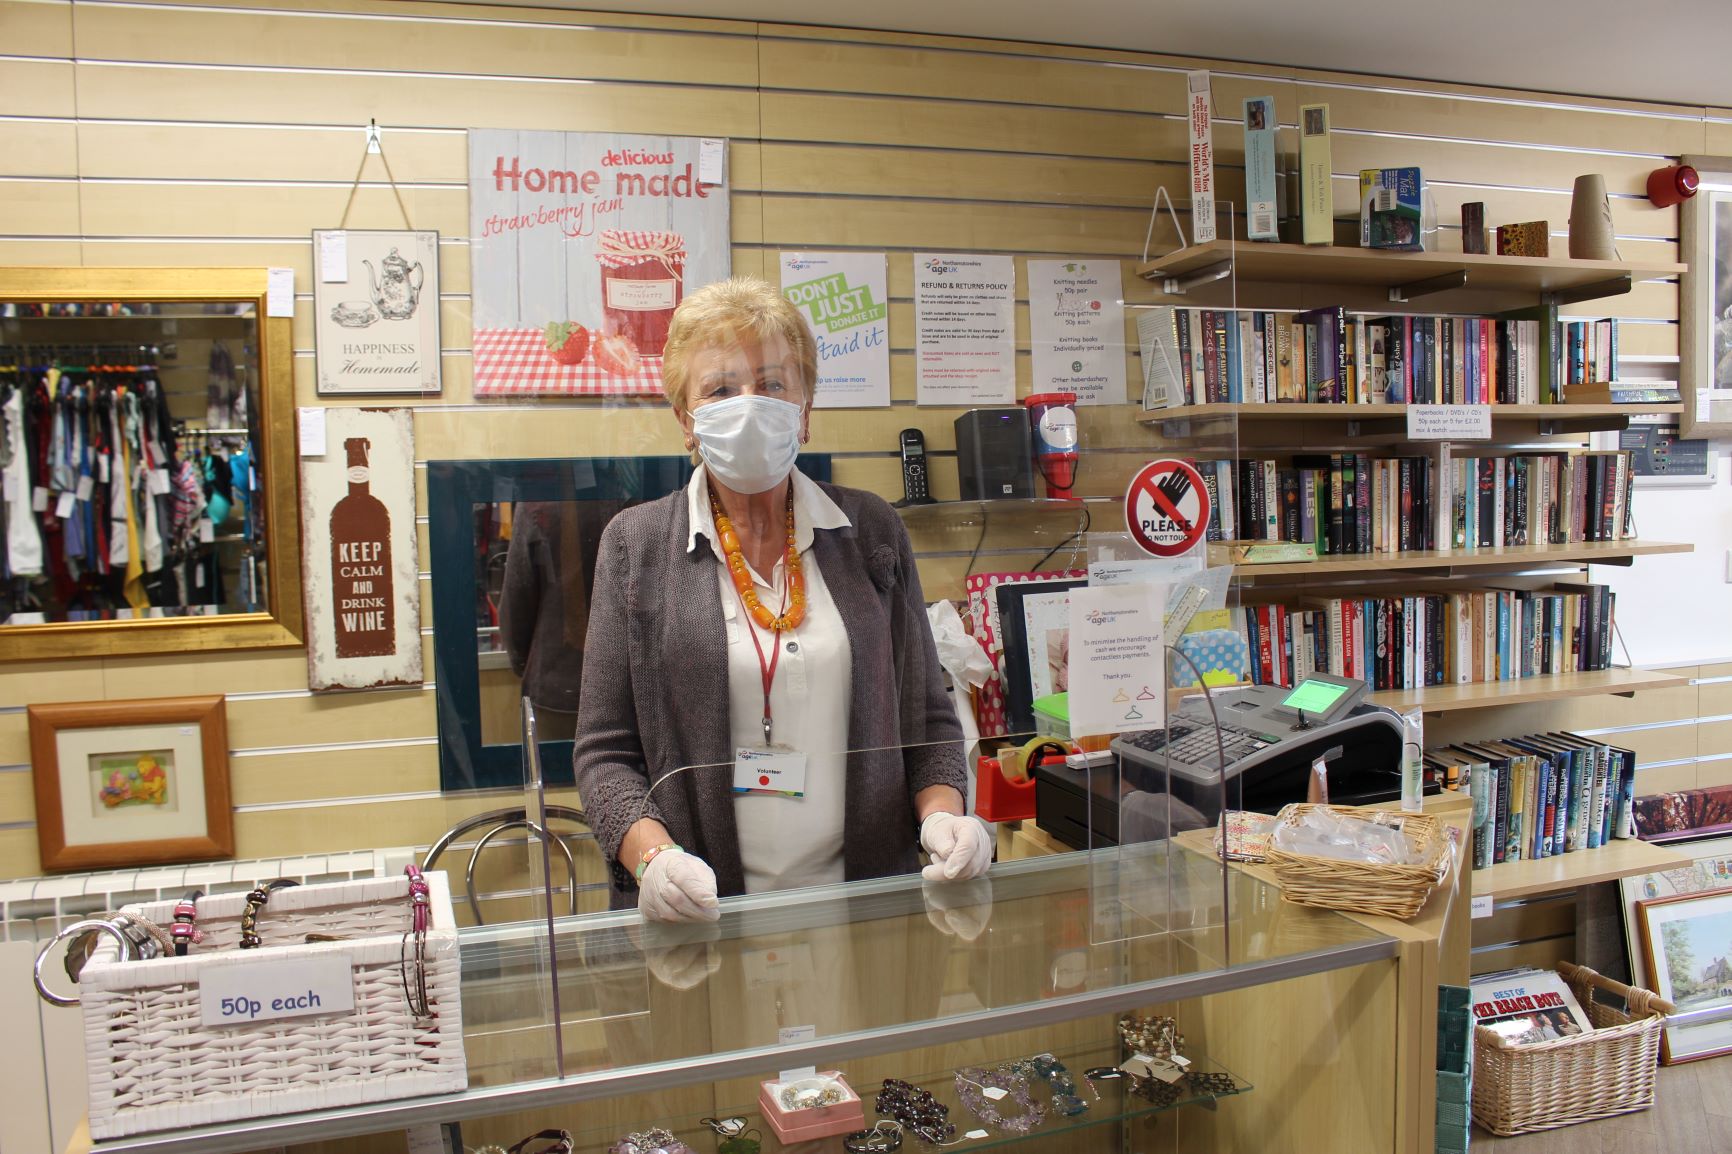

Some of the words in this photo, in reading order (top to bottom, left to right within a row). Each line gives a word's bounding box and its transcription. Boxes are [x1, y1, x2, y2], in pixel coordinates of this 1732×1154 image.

[601, 149, 674, 167] delicious
[1193, 144, 1201, 177] Difficult
[1201, 142, 1209, 172] World's
[492, 156, 600, 194] Home
[616, 163, 714, 198] made
[1202, 173, 1210, 193] Most
[1400, 178, 1409, 197] Mat
[482, 200, 584, 237] strawberry
[580, 195, 624, 236] jam
[932, 266, 948, 275] age
[788, 276, 839, 304] DON'T
[816, 289, 864, 321] JUST
[830, 313, 867, 329] DONATE
[869, 308, 880, 319] IT
[865, 327, 884, 347] it
[1206, 321, 1214, 355] SNAP
[343, 344, 415, 355] HAPPINESS
[340, 360, 421, 374] Homemade
[1608, 466, 1616, 501] PIRATES
[1143, 520, 1192, 532] PLEASE
[339, 542, 382, 563] KEEP
[340, 566, 383, 577] CALM
[352, 581, 373, 594] AND
[341, 598, 386, 609] DRINK
[341, 611, 386, 632] WINE
[1092, 617, 1106, 626] age
[1127, 635, 1151, 644] handling
[1123, 652, 1151, 660] payments.
[1499, 767, 1507, 787] JAMES
[1583, 752, 1592, 786] SLAUGHTER
[1596, 752, 1605, 788] SLAUGHTER
[1547, 767, 1555, 804] PATTERSON
[1559, 768, 1567, 807] PATTERSON
[1498, 790, 1506, 818] HERBERT
[1596, 793, 1605, 825] broken
[1555, 808, 1567, 844] UNSOLVED
[1581, 801, 1589, 835] genesis
[221, 997, 261, 1018] 50p
[271, 990, 320, 1011] each
[1492, 989, 1514, 1000] BEST
[1514, 988, 1526, 997] OF
[1473, 1001, 1497, 1018] THE
[1497, 996, 1534, 1014] BEACH
[1535, 992, 1565, 1008] BOYS
